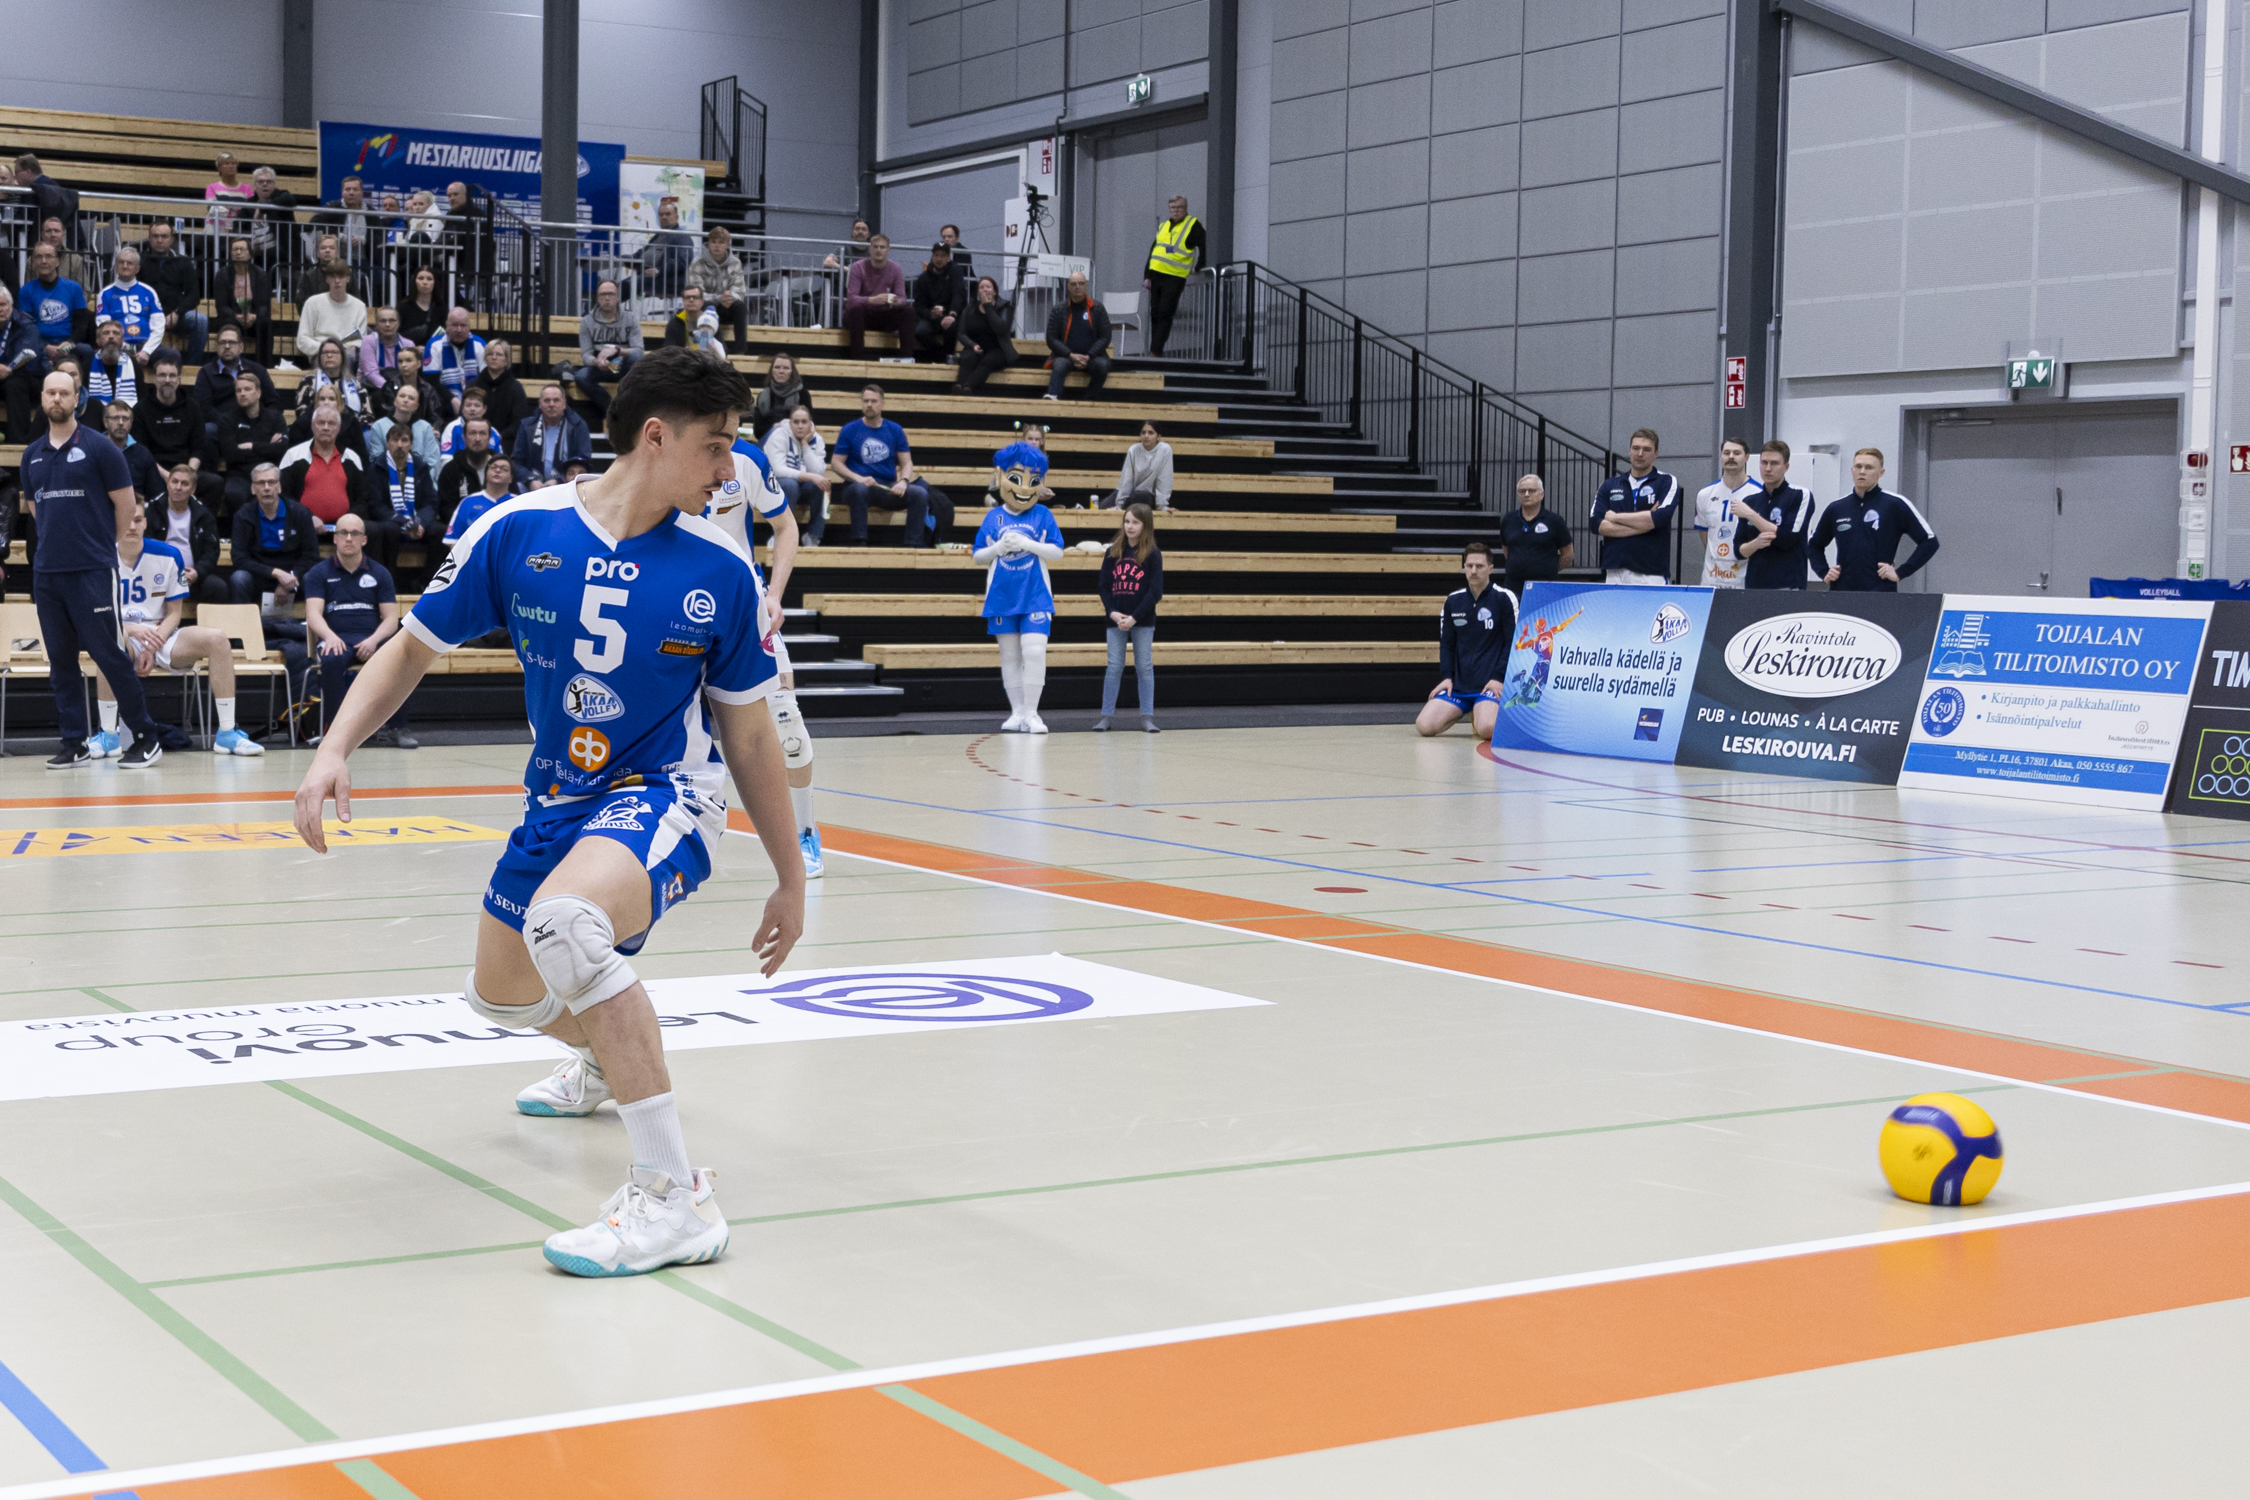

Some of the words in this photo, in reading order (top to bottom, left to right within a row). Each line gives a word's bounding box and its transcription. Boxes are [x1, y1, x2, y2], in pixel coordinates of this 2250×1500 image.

[119, 296, 142, 314] 15
[585, 557, 640, 582] pro
[1112, 563, 1145, 580] SUPER
[120, 575, 147, 605] 15
[2140, 588, 2181, 597] VOLLEYBALL
[573, 584, 630, 674] 5
[1484, 619, 1494, 629] 10
[1664, 619, 1687, 630] AKAA
[1776, 622, 1857, 646] Ravintola
[2036, 624, 2144, 646] TOIJALAN
[1560, 646, 1613, 667] Vahvalla
[1616, 648, 1665, 670] kädellä
[1666, 652, 1682, 675] ja
[1732, 630, 1887, 681] Leskirouva
[1993, 652, 2139, 677] TILITOIMISTO
[2144, 660, 2181, 679] OY
[1553, 673, 1604, 693] suurella
[1608, 675, 1677, 698] sydämellä
[582, 694, 617, 706] AKAA
[1936, 702, 1951, 714] 50
[1991, 692, 2045, 708] Kirjanpito
[2046, 696, 2057, 709] ja
[2059, 697, 2141, 713] palkkahallinto
[1697, 708, 1725, 723] PUB
[1741, 711, 1800, 728] LOUNAS
[1815, 712, 1826, 730] À
[1829, 716, 1848, 732] LA
[1850, 718, 1900, 735] CARTE
[1986, 712, 2082, 729] Isännöintipalvelut
[1722, 736, 1857, 763] LESKIROUVA.FI
[536, 757, 553, 770] OP
[1955, 750, 1988, 763] Myllytie
[2023, 756, 2048, 767] 37801
[2076, 760, 2092, 771] 050
[2093, 762, 2115, 772] 5555
[2116, 764, 2134, 774] 867
[25, 1010, 261, 1031] muovista
[55, 1023, 357, 1051] Group
